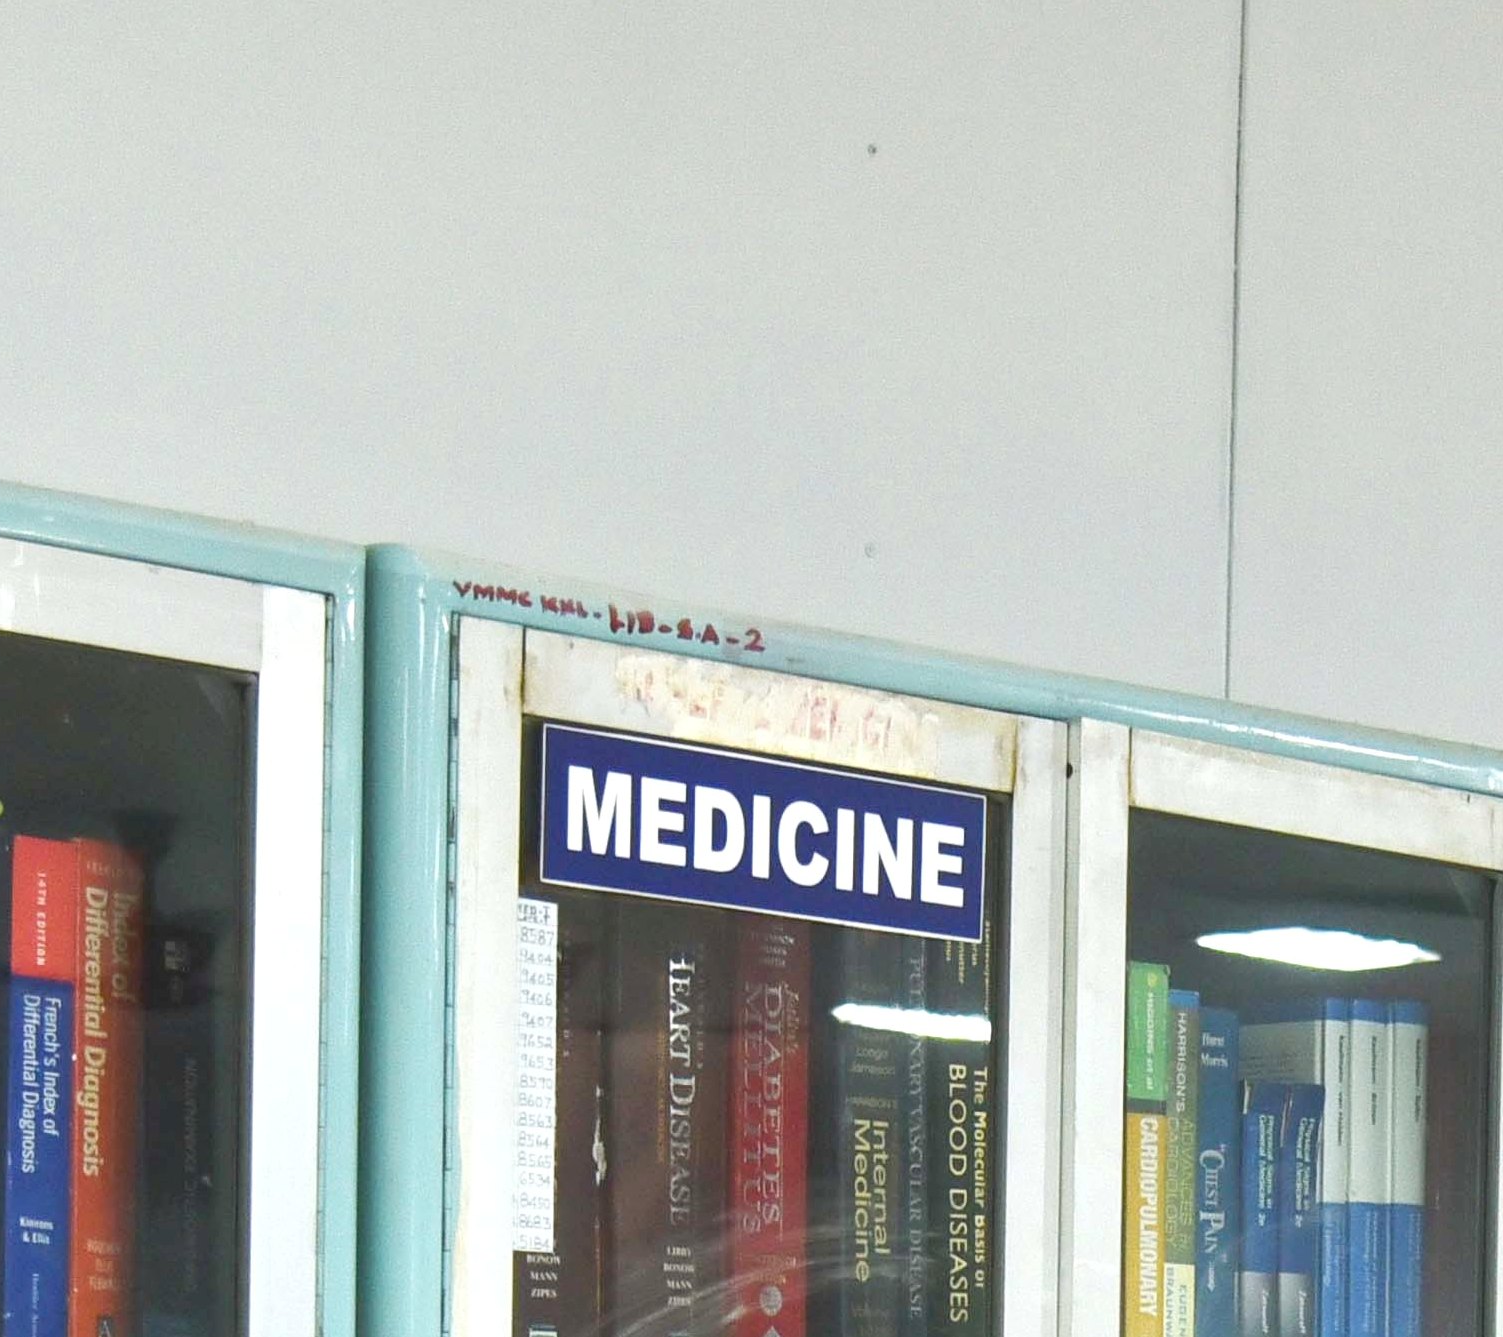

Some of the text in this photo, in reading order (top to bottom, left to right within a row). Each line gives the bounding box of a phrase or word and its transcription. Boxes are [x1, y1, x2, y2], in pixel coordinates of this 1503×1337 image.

[566, 766, 966, 908] MEDICINE
[21, 994, 40, 1174] Differential Diagnosis
[82, 887, 108, 1176] Differential Diagnosis
[853, 1117, 872, 1284] Medicine
[872, 1119, 893, 1258] Internal
[947, 1062, 969, 1325] BLOOD DISEASES
[1140, 1117, 1160, 1318] CARDIOPULMONARY
